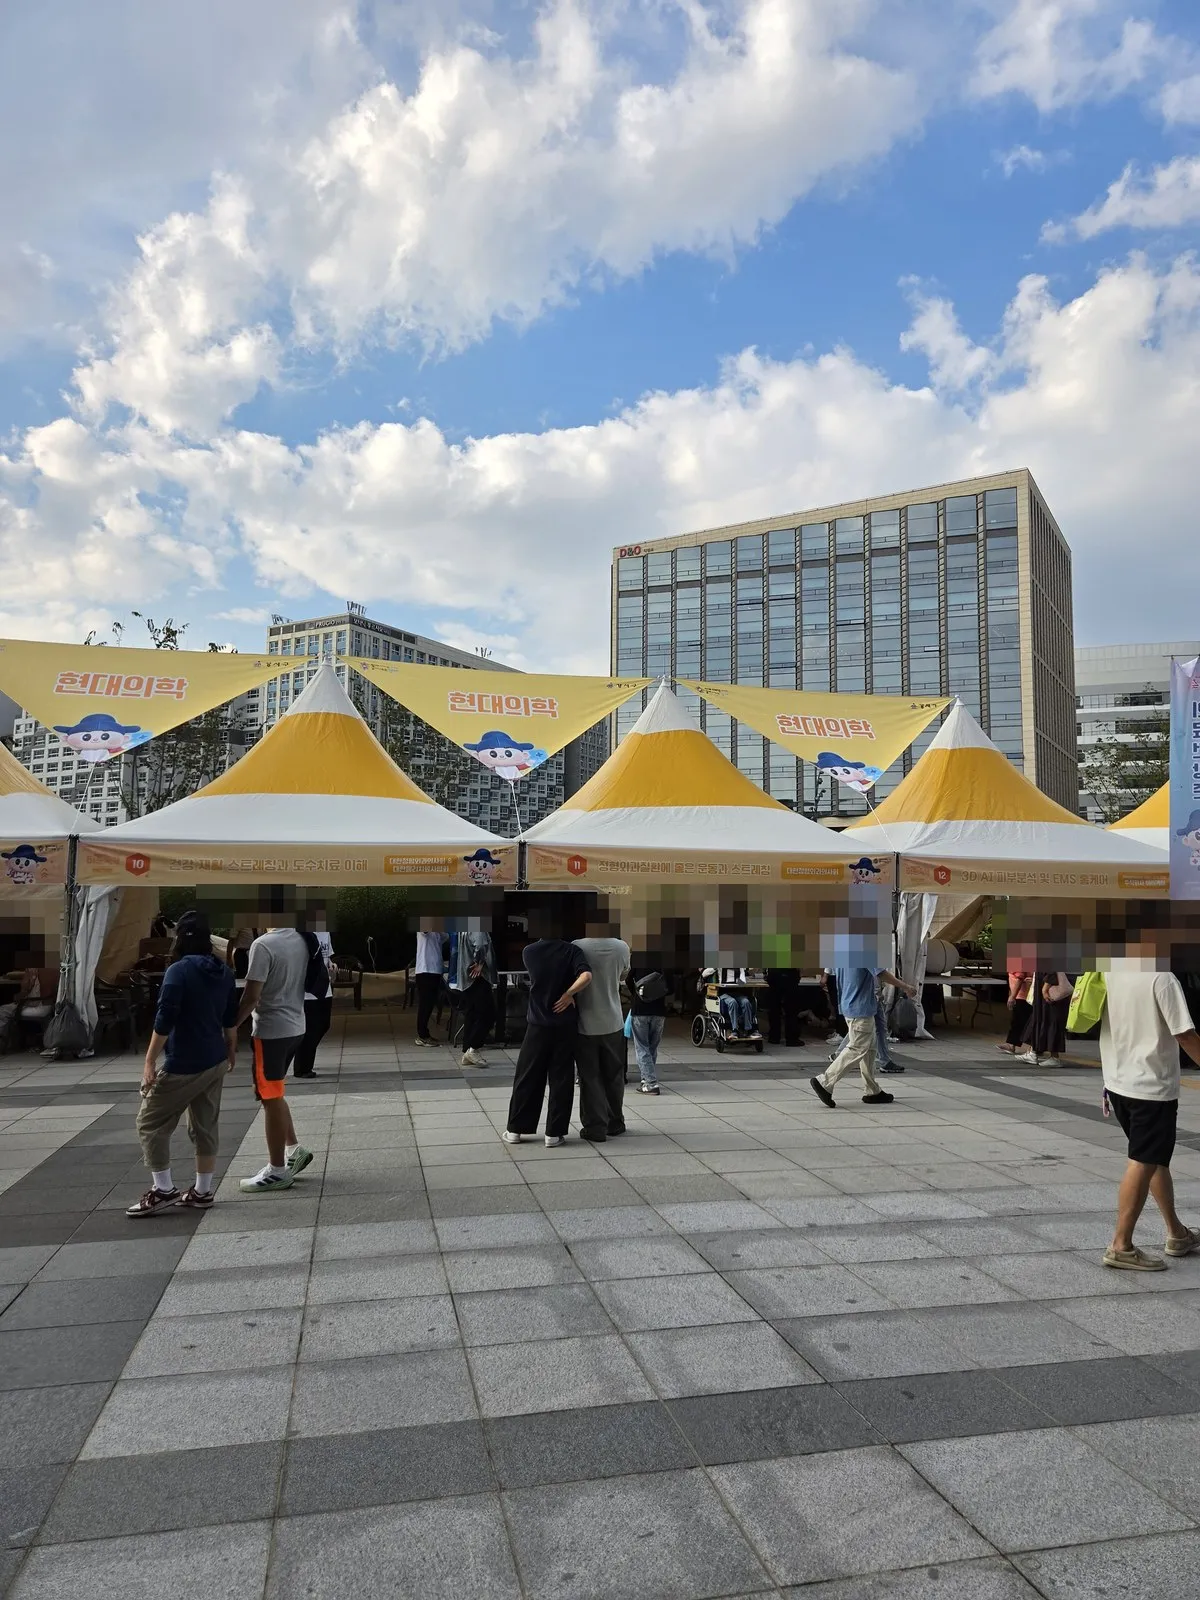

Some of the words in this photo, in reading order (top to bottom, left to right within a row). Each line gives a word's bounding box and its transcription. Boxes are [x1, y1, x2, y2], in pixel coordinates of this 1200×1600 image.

[619, 545, 641, 557] D&O
[53, 671, 189, 700] 현대의학
[448, 690, 559, 719] 현대의학
[776, 713, 876, 741] 현대의학
[132, 859, 144, 870] 10
[227, 859, 289, 873] 스트레칭과
[293, 858, 341, 872] 도수치료
[344, 858, 369, 872] 이해
[574, 860, 581, 870] 11
[598, 860, 672, 874] 정형외과질환에
[674, 861, 696, 875] 좋은
[697, 862, 728, 876] 운동과
[731, 863, 771, 877] 스트레칭
[938, 871, 947, 880] 12
[961, 870, 978, 883] 3D
[980, 871, 996, 883] AI
[997, 872, 1037, 885] 피부분석
[1040, 872, 1050, 884] 및
[1053, 872, 1077, 885] EMS
[1079, 873, 1109, 887] 홈케어
